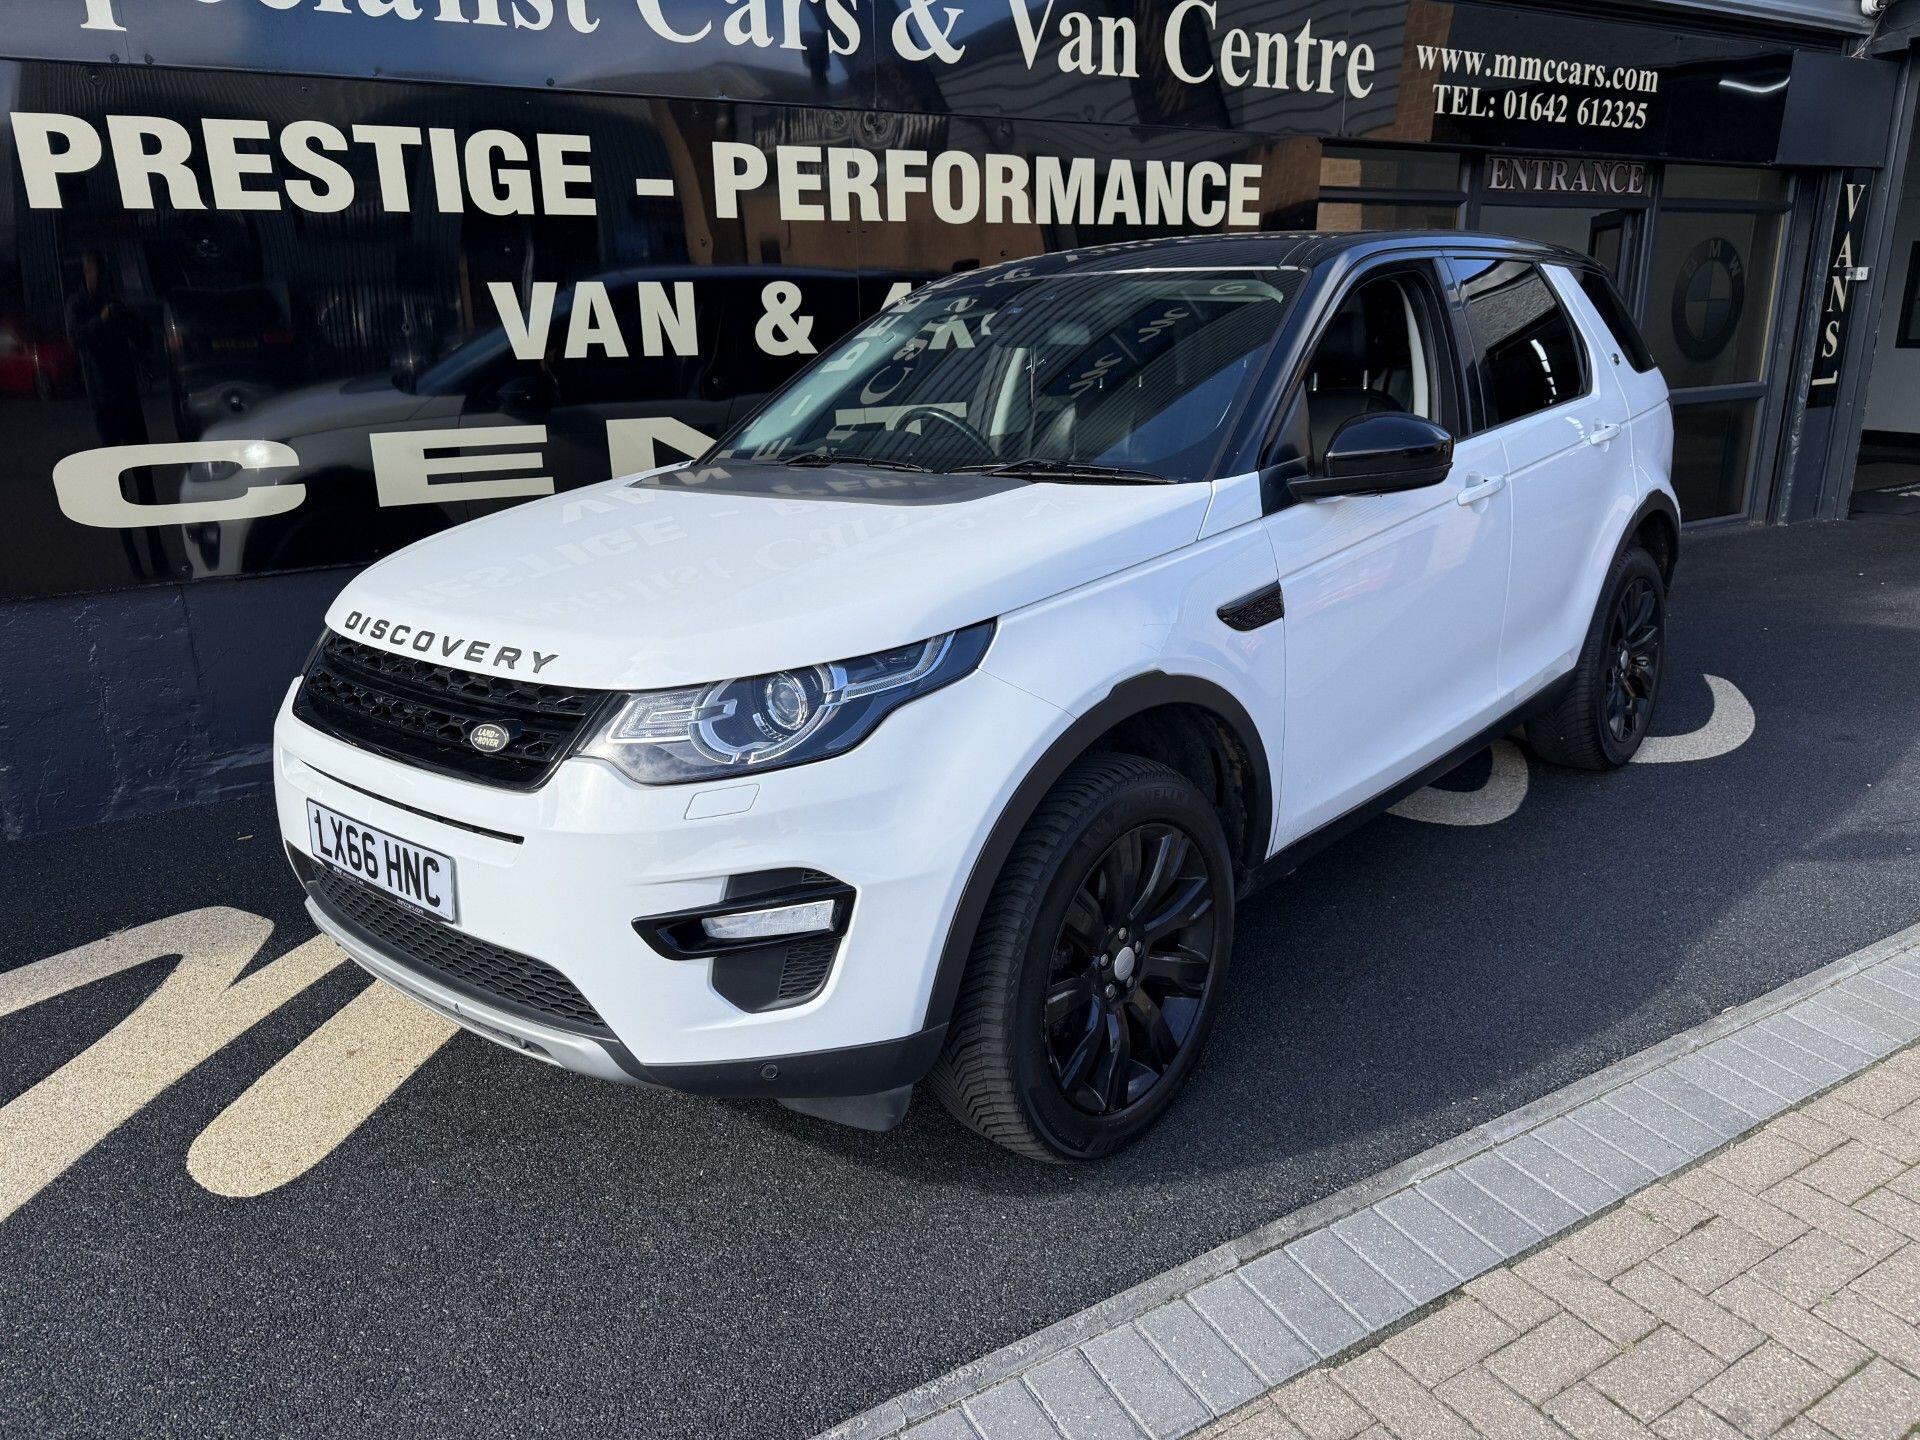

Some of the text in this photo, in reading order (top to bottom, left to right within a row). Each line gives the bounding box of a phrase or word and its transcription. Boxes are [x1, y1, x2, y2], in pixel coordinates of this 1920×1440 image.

[891, 0, 966, 64] &
[1008, 0, 1140, 78] Van
[1164, 0, 1375, 99] Centre
[1416, 44, 1659, 94] www.mmccars.com
[1432, 83, 1648, 130] TEL: 01642 612325
[9, 111, 597, 216] PRESTIGE
[711, 141, 1263, 227] PERFORMANCE
[1487, 157, 1645, 195] ENTRANCE
[1823, 184, 1866, 358] VANS
[486, 281, 700, 360] VAN
[754, 280, 819, 356] &
[344, 610, 559, 674] DISCOVERY
[314, 809, 441, 908] LX66 HNC
